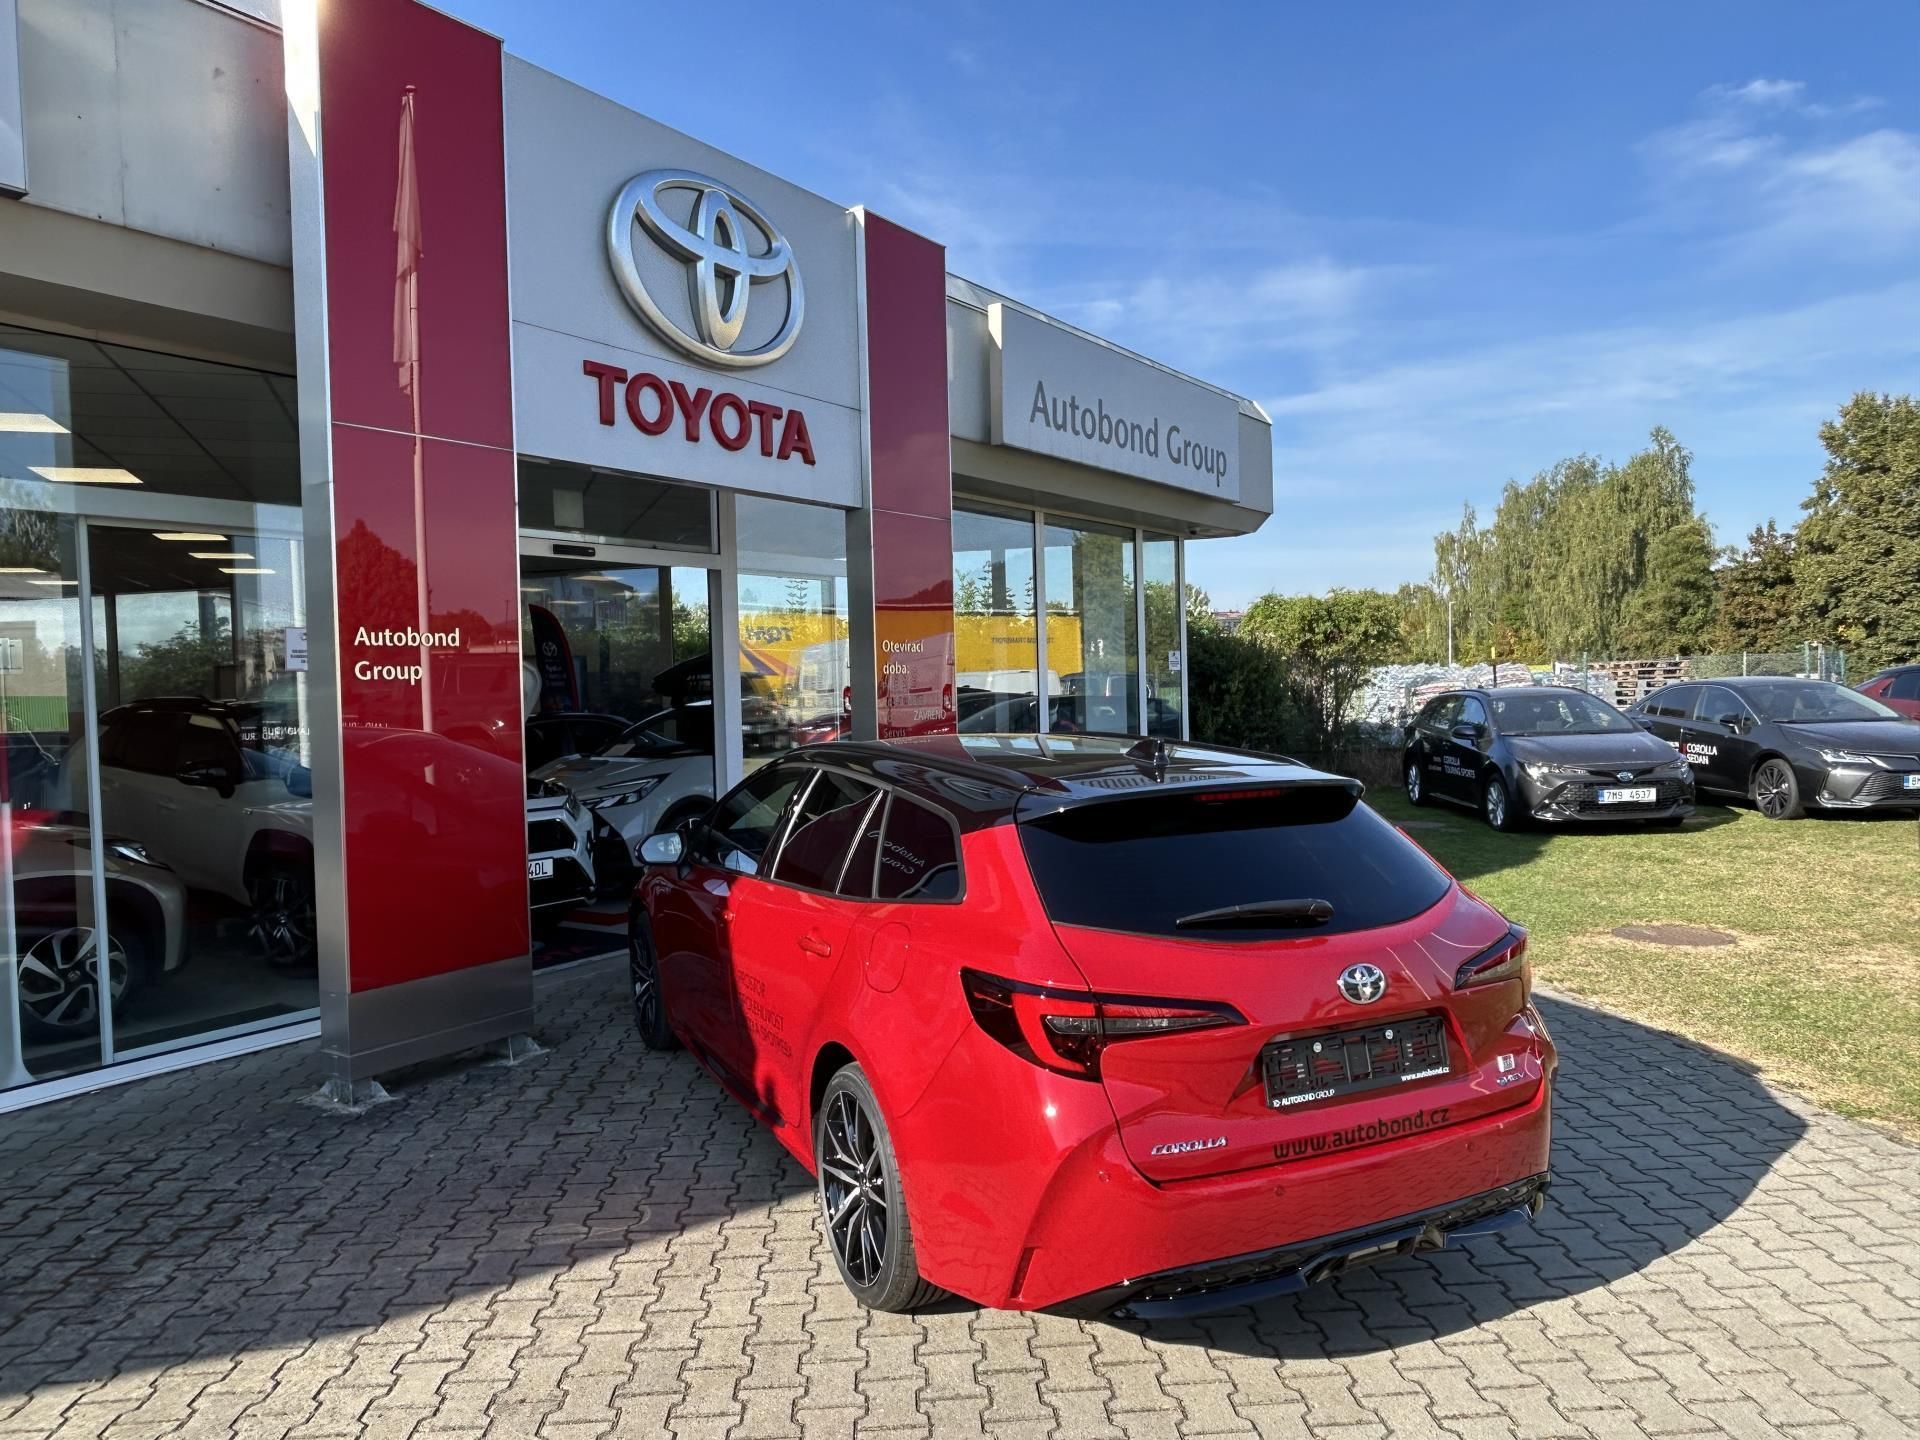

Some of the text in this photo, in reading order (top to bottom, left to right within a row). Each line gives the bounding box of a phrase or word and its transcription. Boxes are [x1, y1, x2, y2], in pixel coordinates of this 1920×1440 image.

[583, 360, 816, 465] TOYOTA
[1030, 380, 1227, 487] Autobond Group
[354, 626, 460, 646] Autobond
[354, 661, 423, 686] Group
[1687, 743, 1718, 756] COROLLA
[1401, 1066, 1450, 1082] www.autobond.cz
[1281, 1088, 1335, 1107] AUTOBOND GROUP
[1273, 1108, 1450, 1159] www.autobond.cz
[1151, 1136, 1228, 1155] COROLLA
